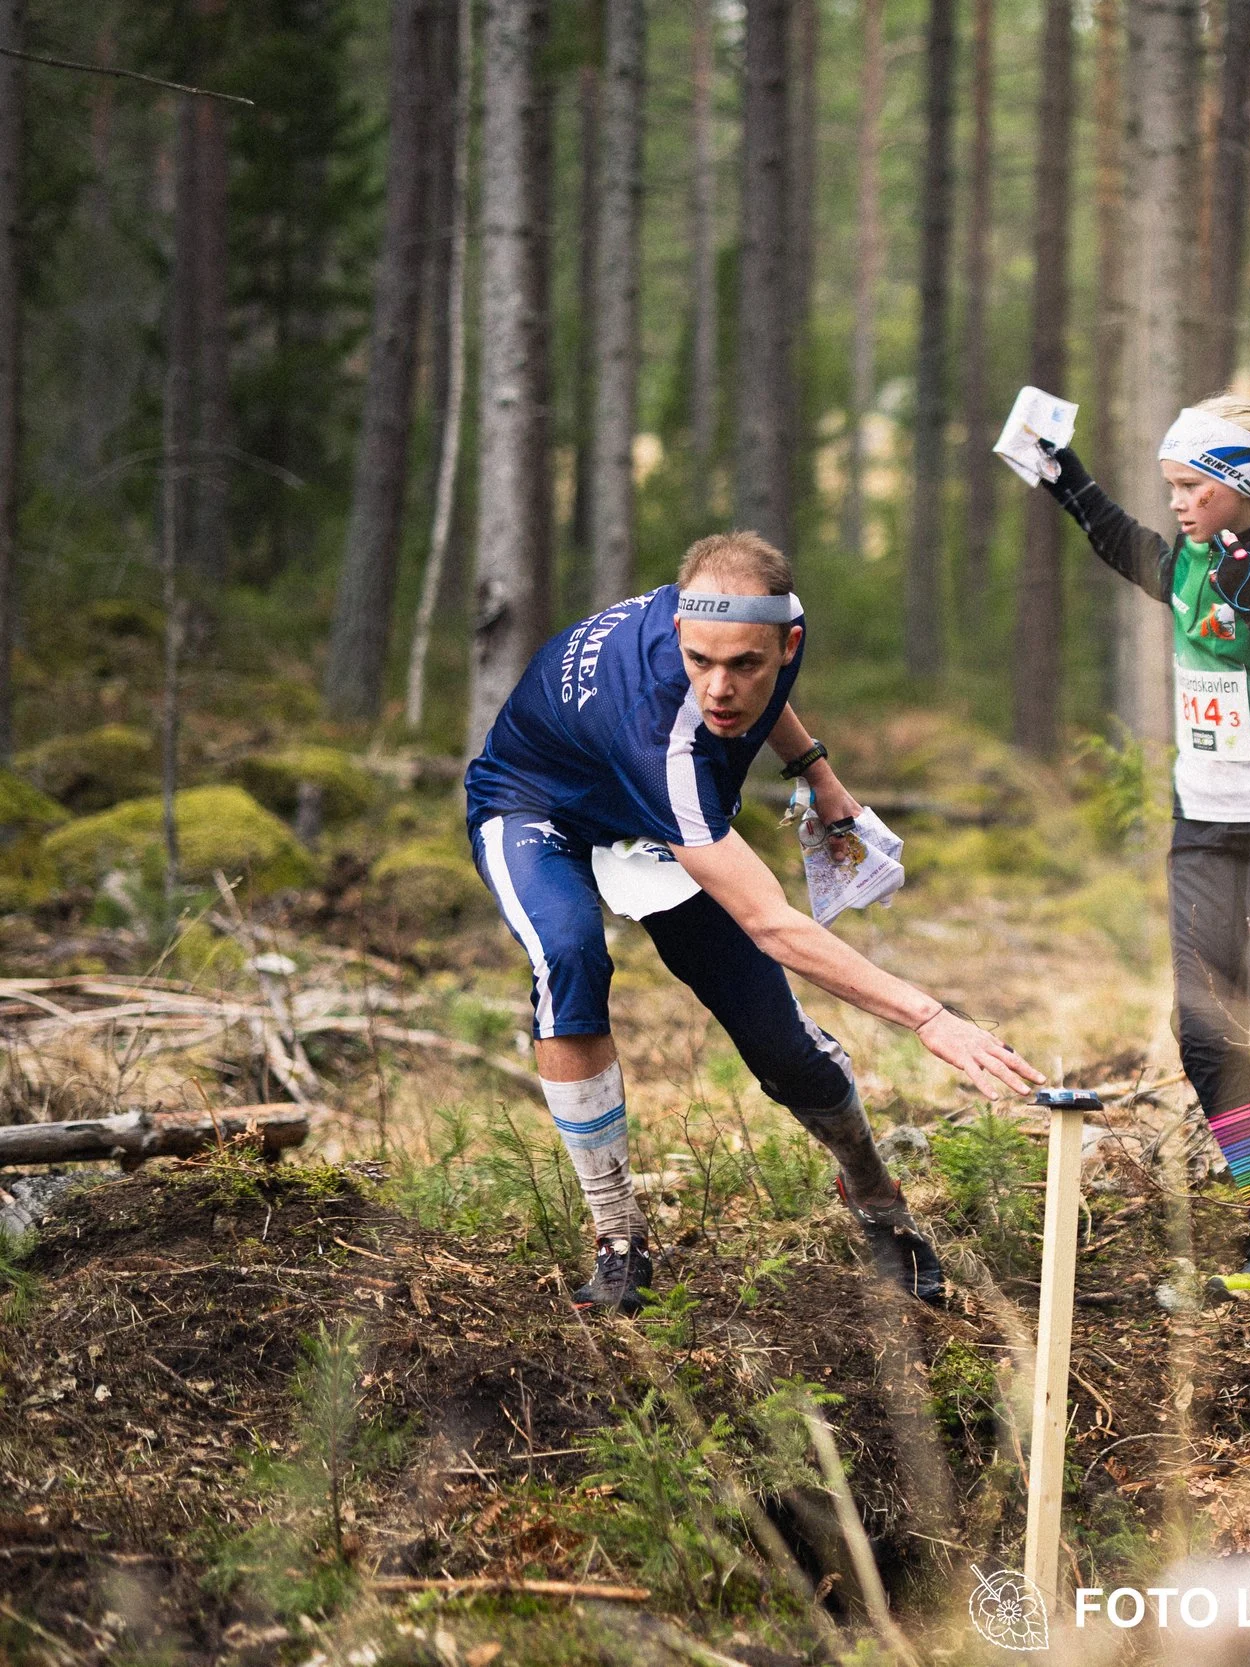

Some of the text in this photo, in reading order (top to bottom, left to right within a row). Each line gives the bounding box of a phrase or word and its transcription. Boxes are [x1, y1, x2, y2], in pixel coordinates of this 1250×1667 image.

[1199, 453, 1244, 480] TRIMTEX
[577, 612, 631, 711] UMEÅ
[1229, 711, 1241, 727] 3
